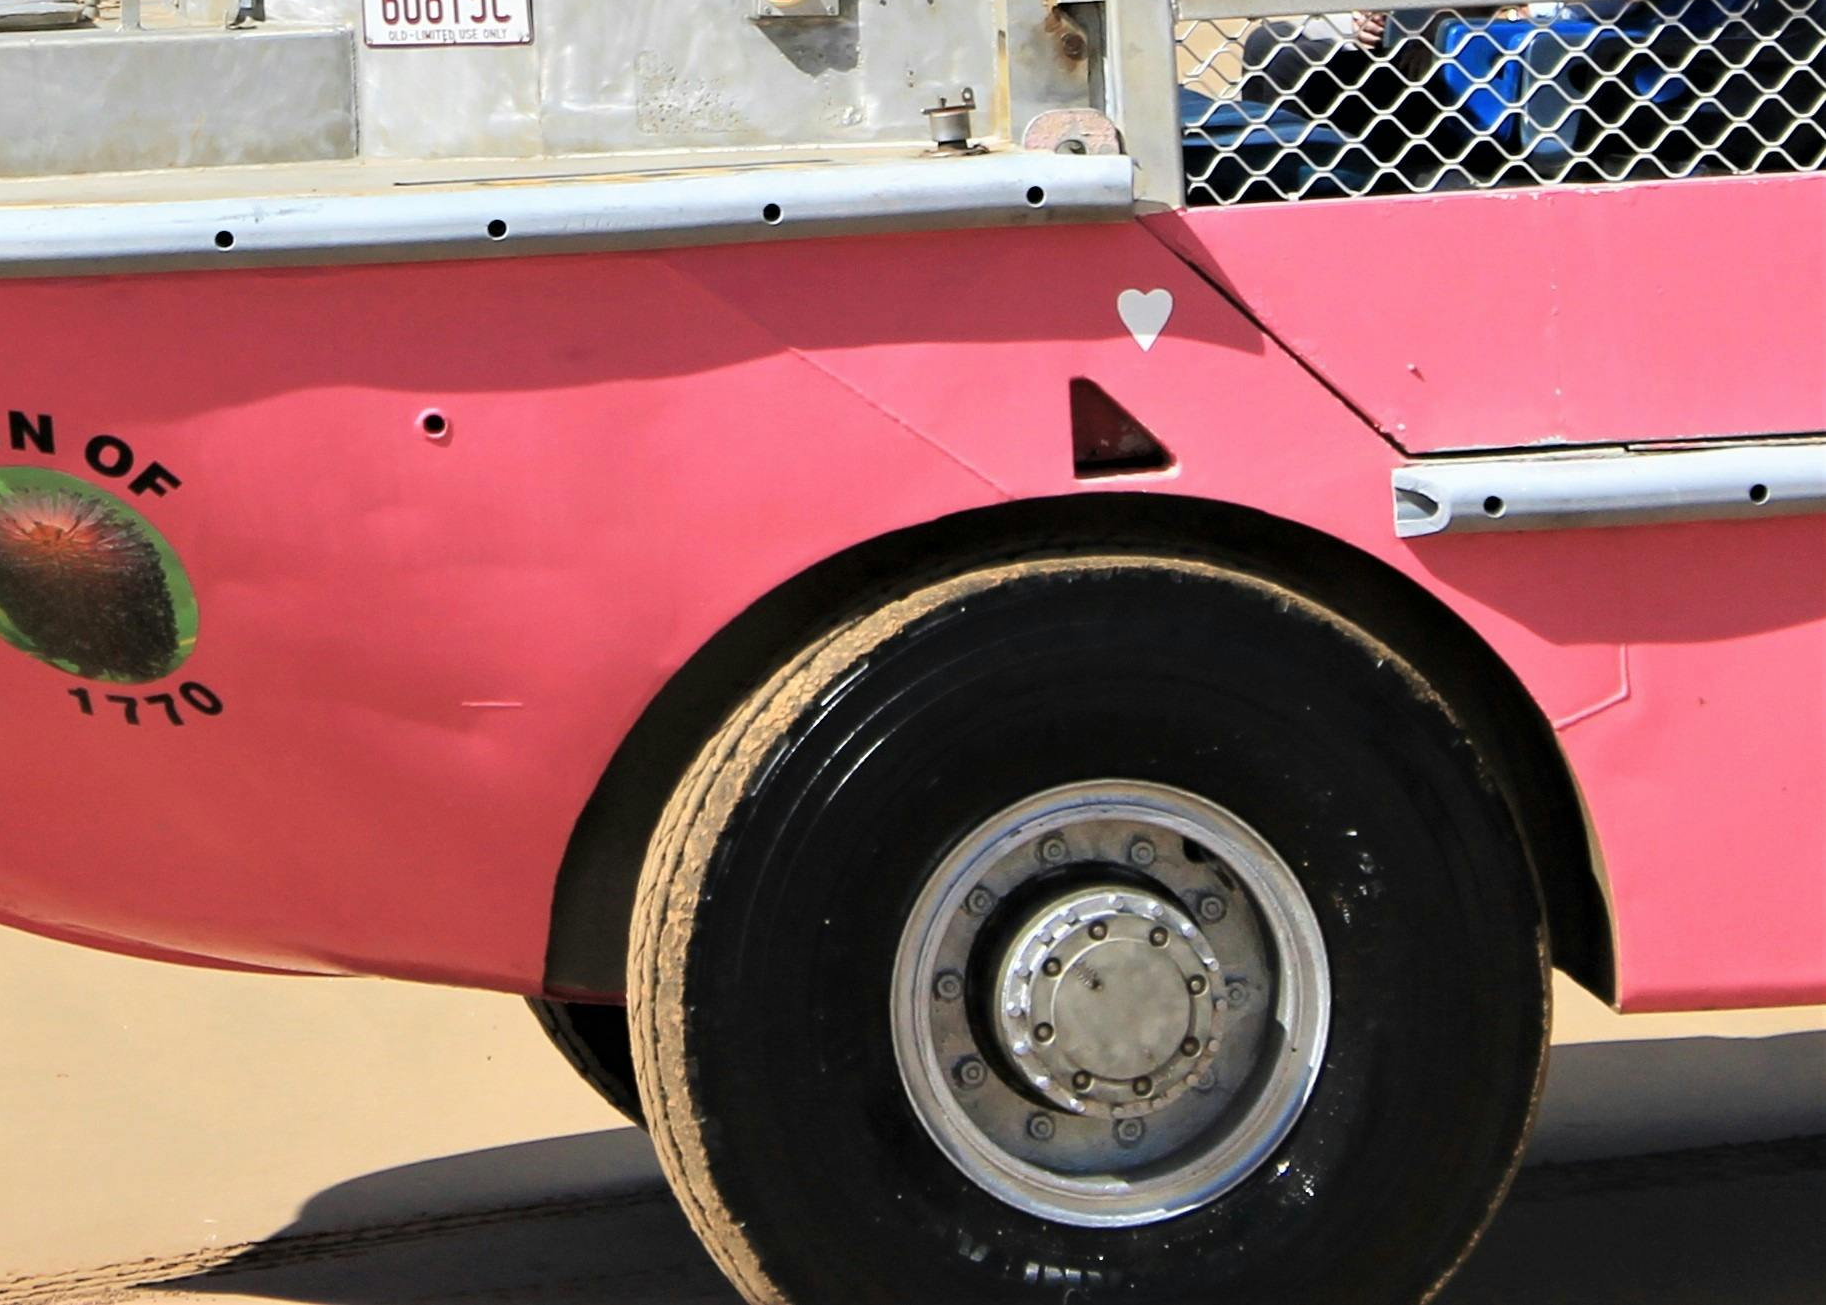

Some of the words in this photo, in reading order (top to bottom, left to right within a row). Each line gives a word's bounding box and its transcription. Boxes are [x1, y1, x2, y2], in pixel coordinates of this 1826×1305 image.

[458, 28, 478, 40] USE
[482, 27, 508, 40] ONLY
[84, 433, 183, 498] OF
[67, 681, 224, 726] 1770
